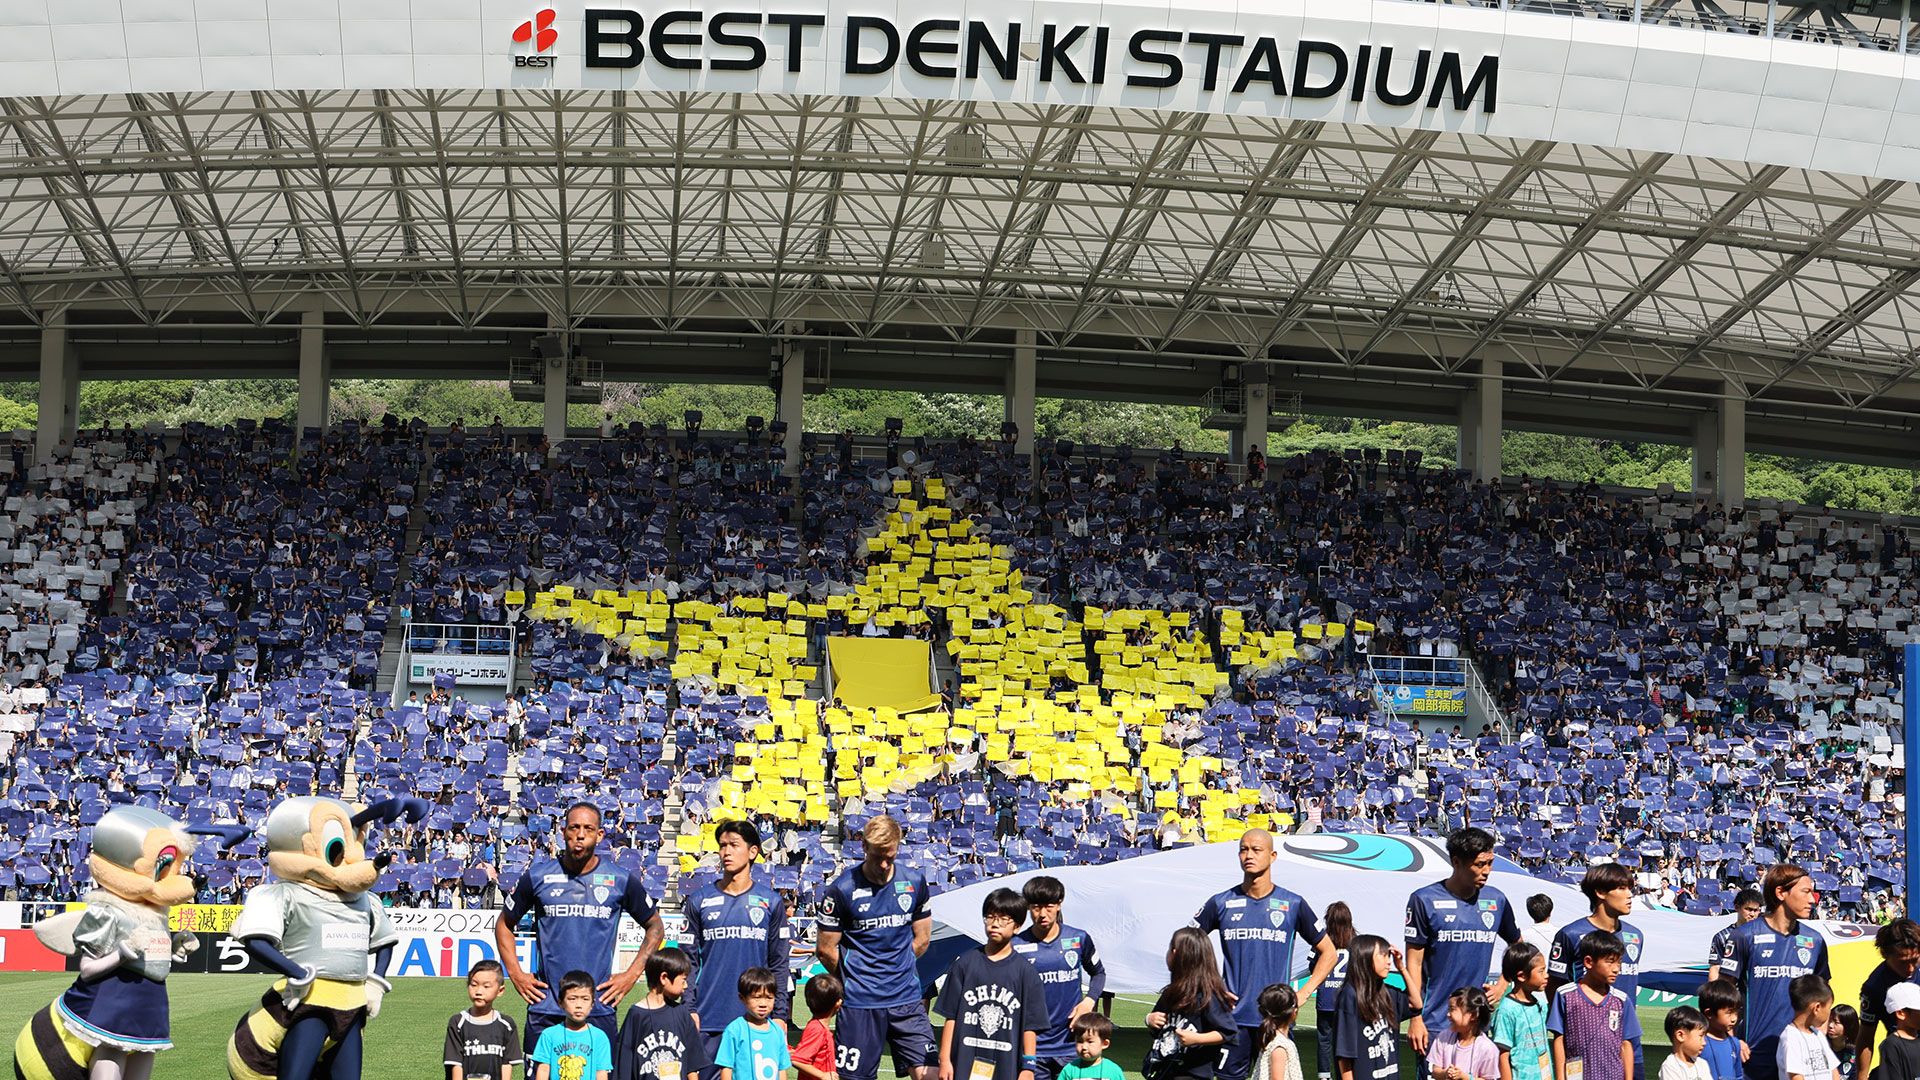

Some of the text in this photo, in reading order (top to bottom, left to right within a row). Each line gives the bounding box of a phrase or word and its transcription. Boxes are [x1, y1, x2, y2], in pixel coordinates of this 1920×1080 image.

[515, 56, 557, 68] BEST
[585, 9, 1499, 113] BEST DENKI STADIUM
[1413, 699, 1464, 712] 岡部病院
[433, 913, 495, 932] 2024
[1224, 928, 1287, 943] 新日本製薬
[835, 1048, 861, 1072] 33
[1218, 1048, 1229, 1070] 7
